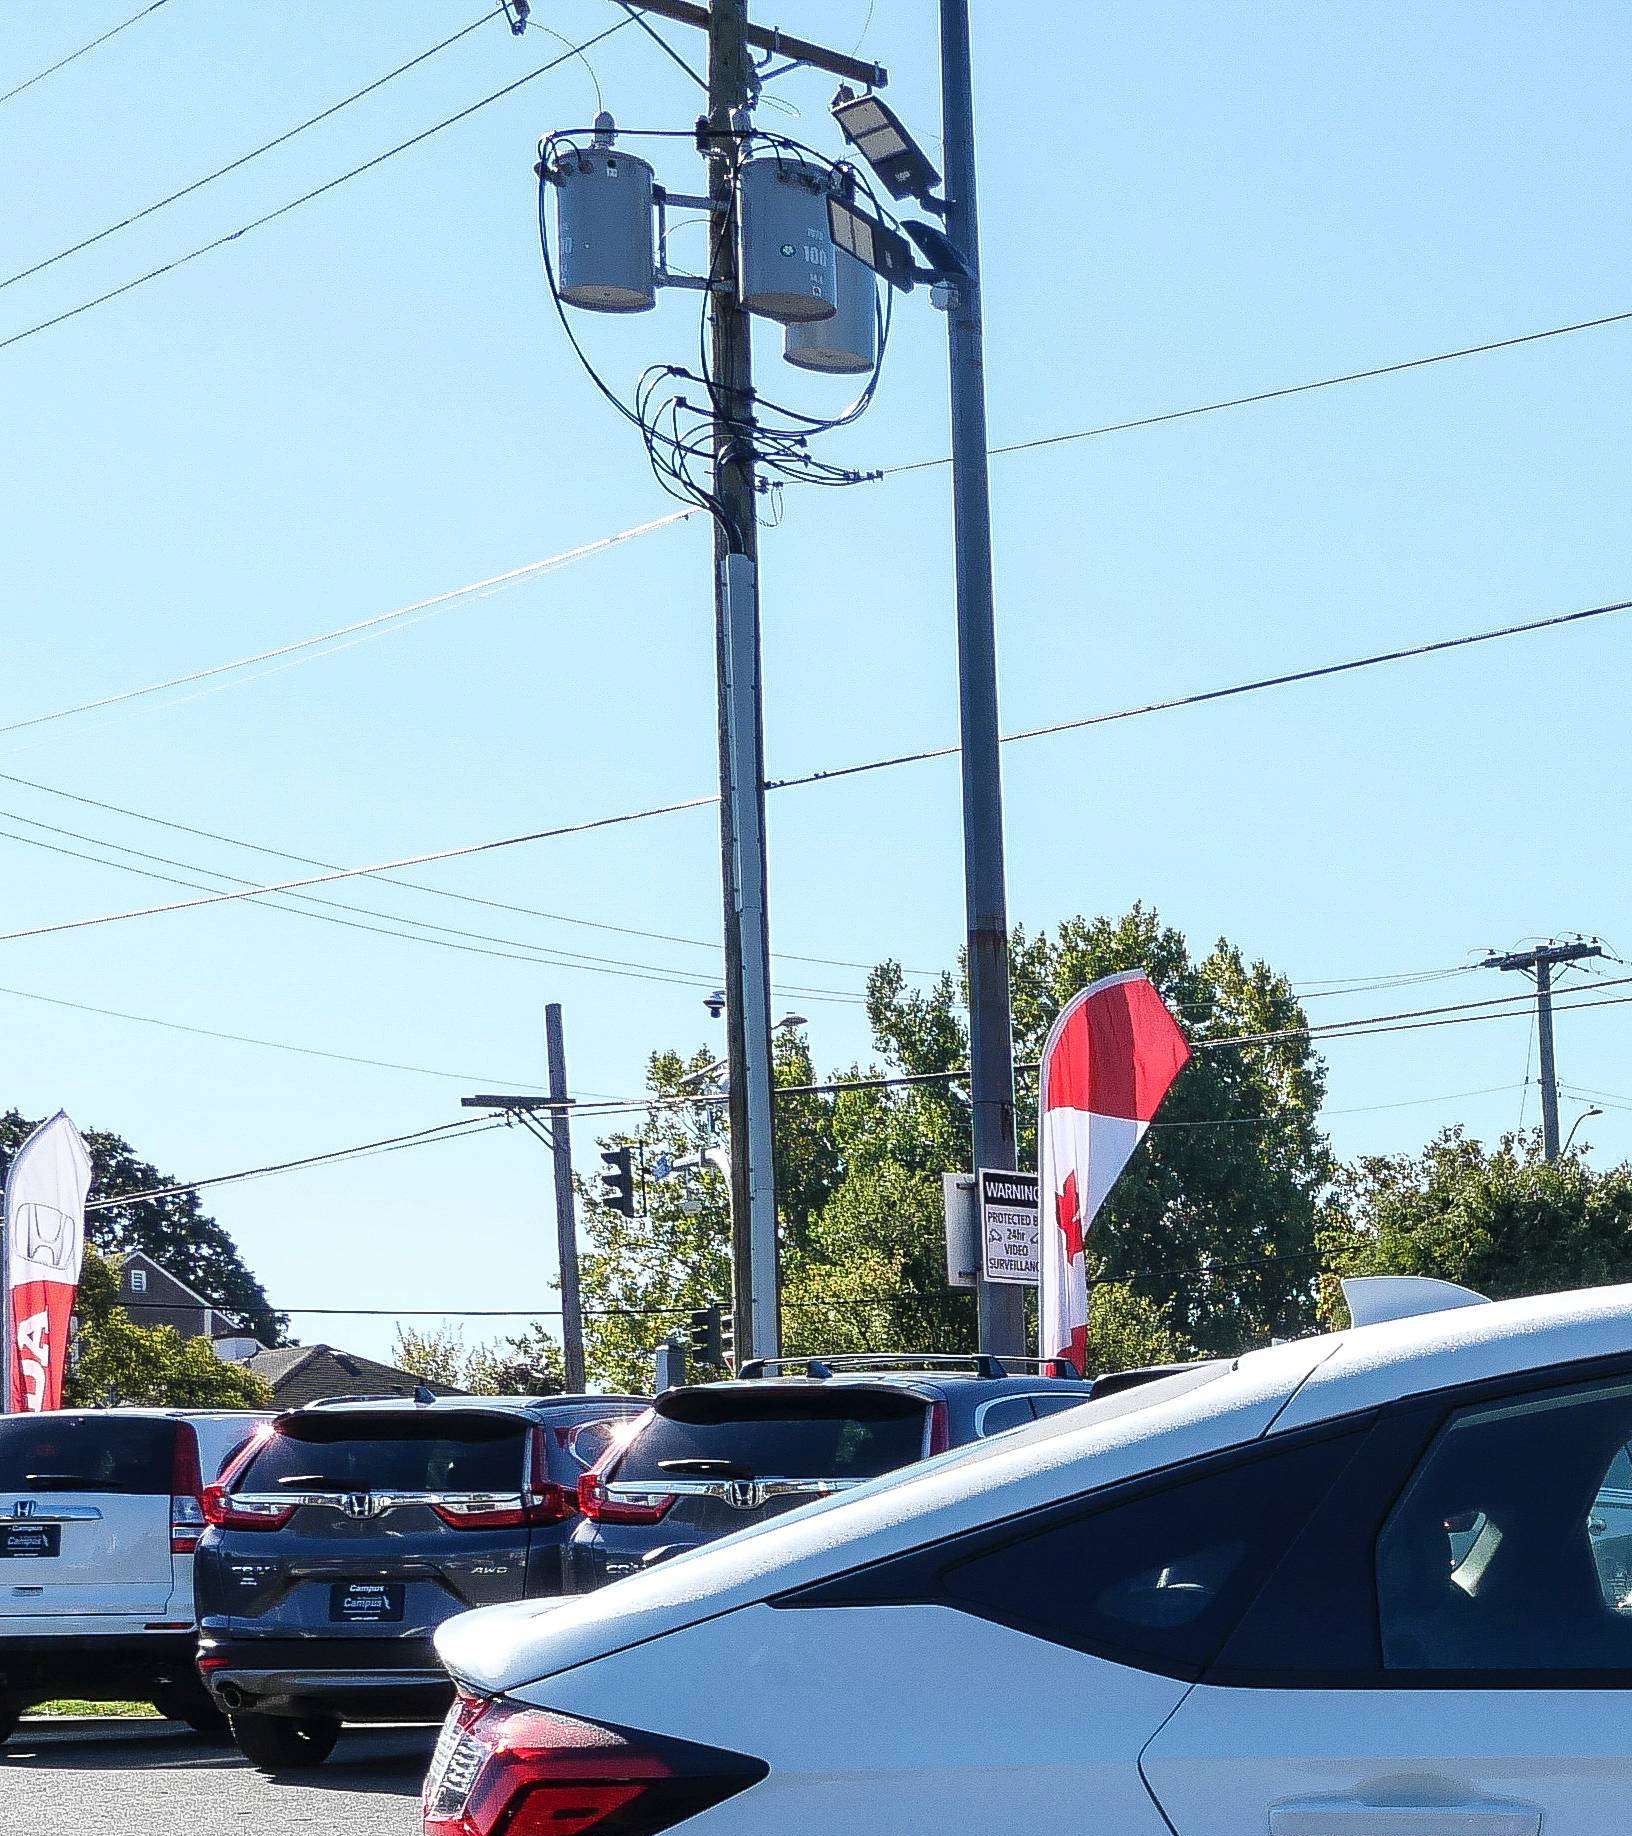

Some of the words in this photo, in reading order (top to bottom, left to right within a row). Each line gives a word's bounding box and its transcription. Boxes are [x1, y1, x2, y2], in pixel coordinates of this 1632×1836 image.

[987, 1212, 1032, 1226] PROTECTED
[1033, 1215, 1039, 1227] B
[1004, 1244, 1029, 1256] VIDEO
[988, 1259, 1039, 1272] SURVEILLAN
[470, 1566, 509, 1574] AWD
[343, 1597, 382, 1611] Campus
